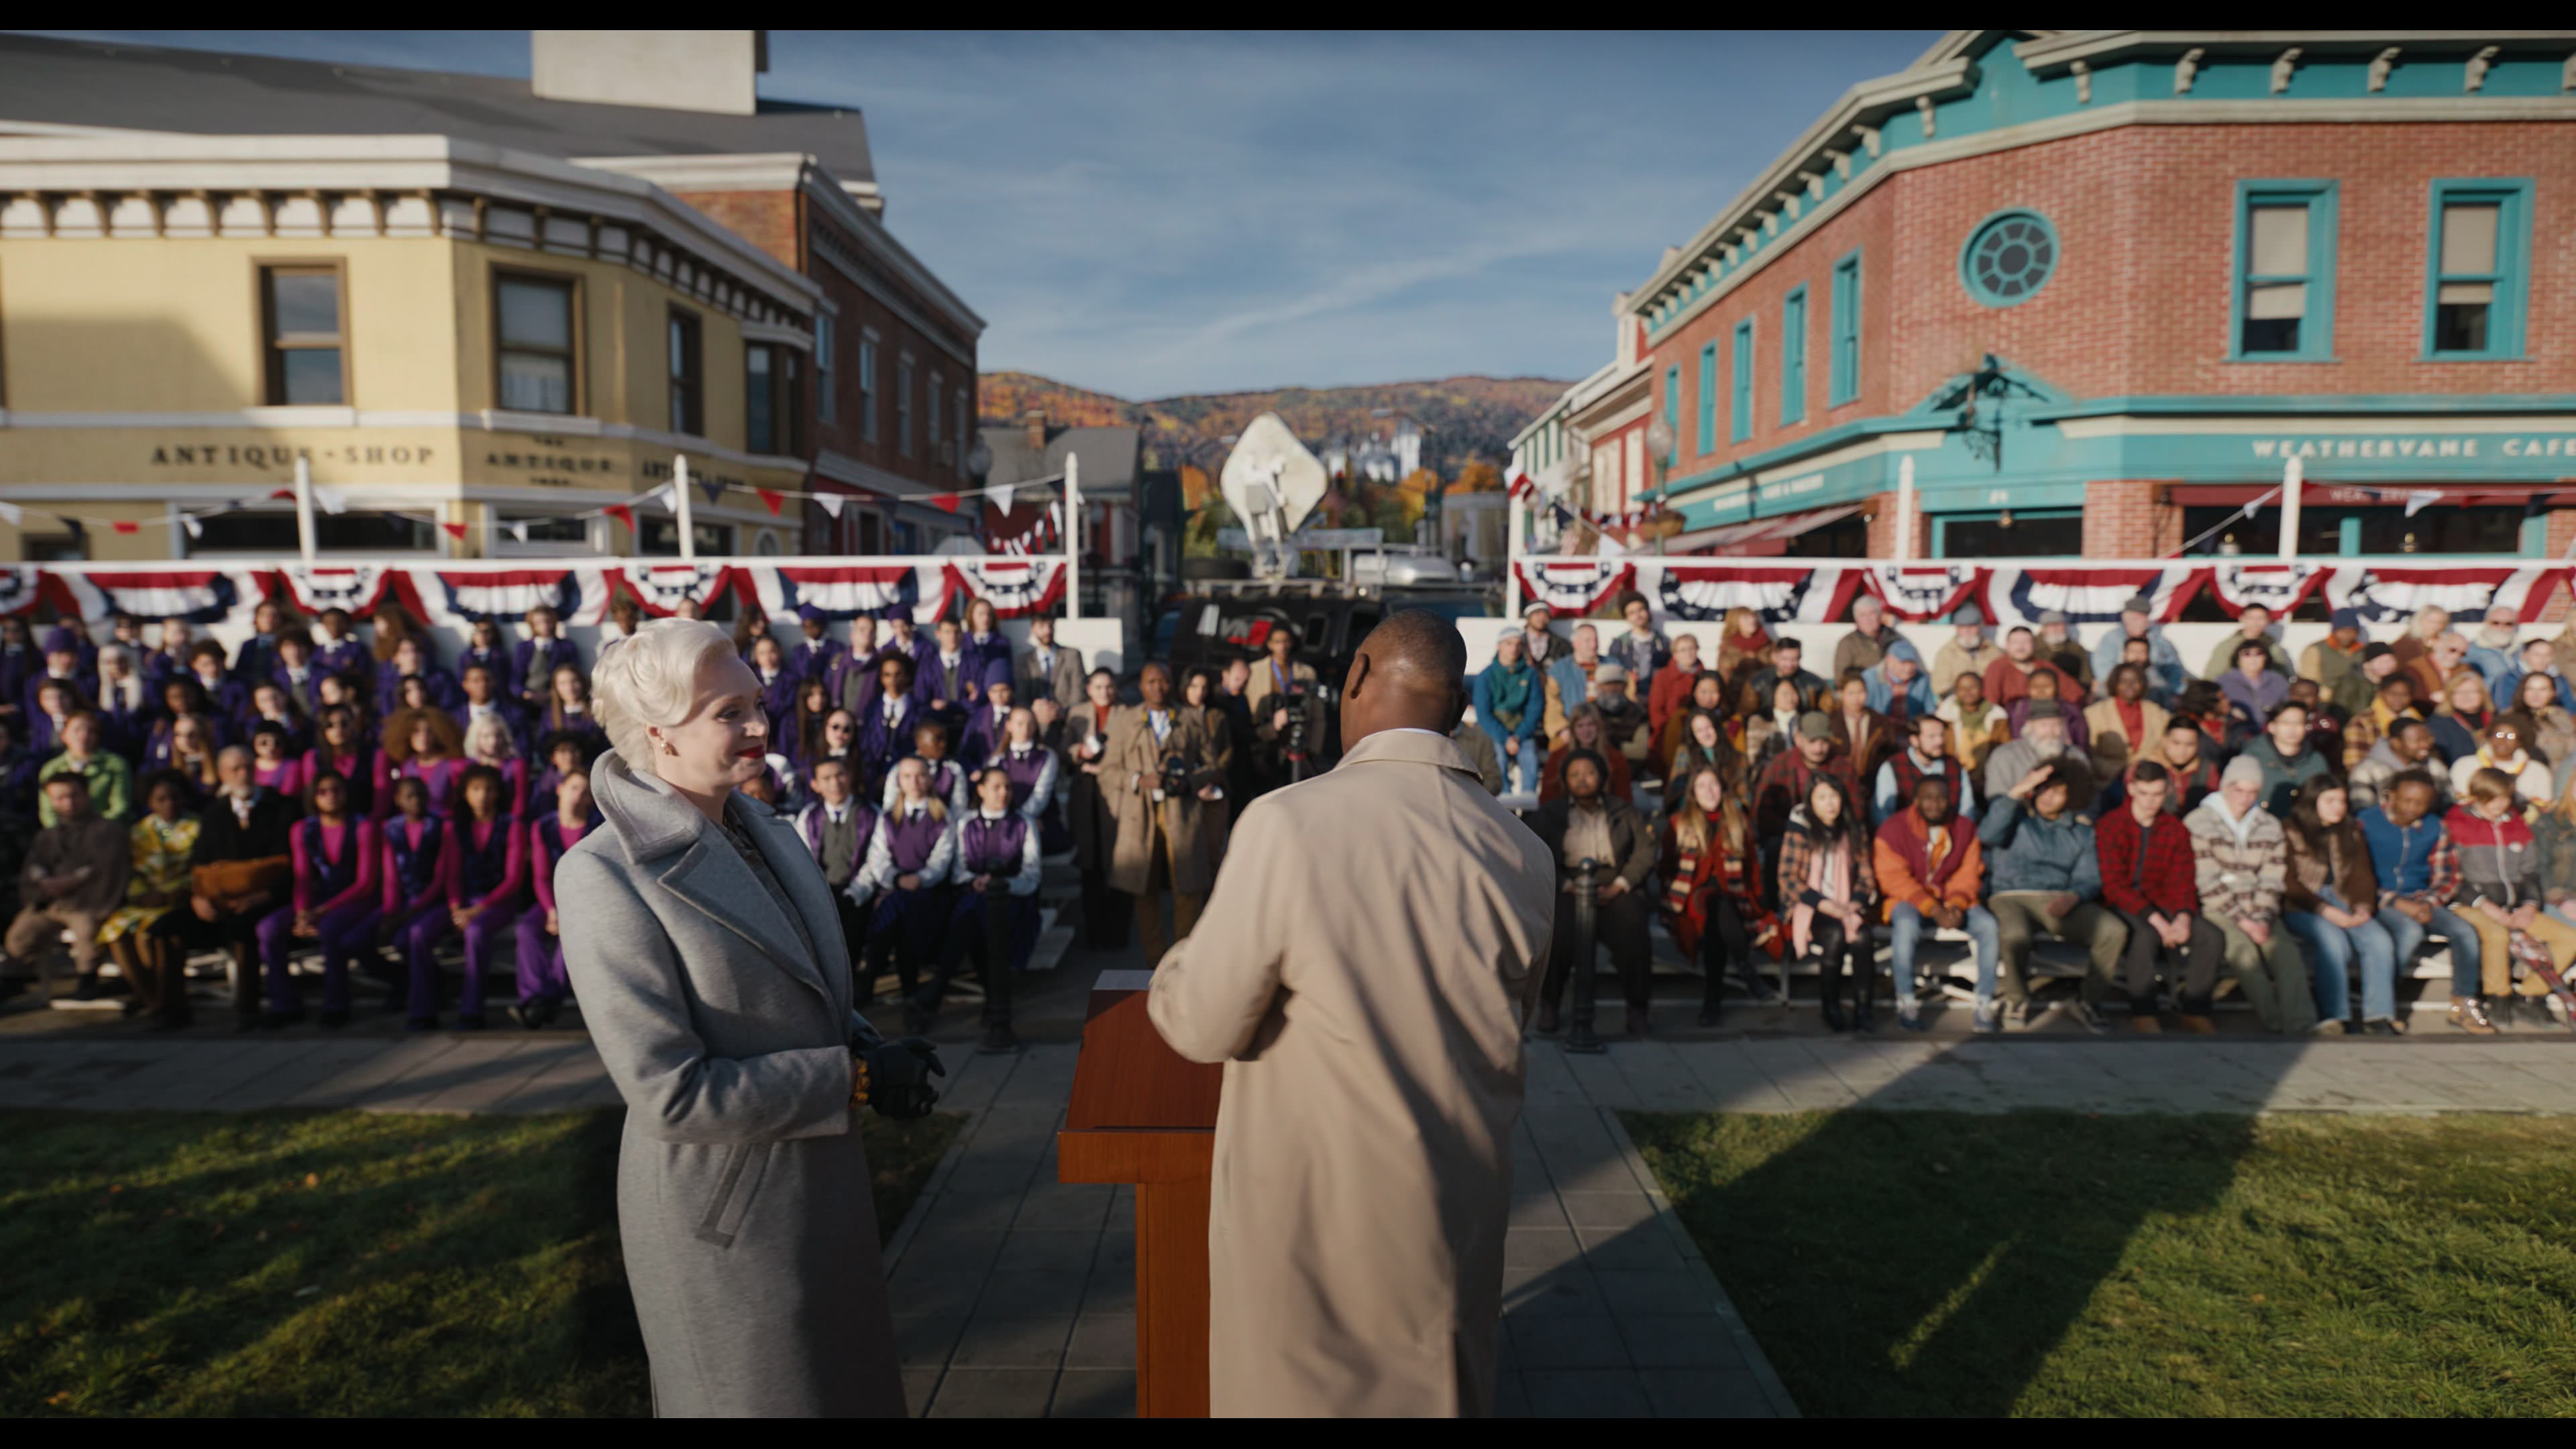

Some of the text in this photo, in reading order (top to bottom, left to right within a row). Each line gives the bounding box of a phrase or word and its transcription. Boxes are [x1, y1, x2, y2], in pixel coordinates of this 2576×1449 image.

[345, 445, 435, 464] SHOP
[2252, 438, 2576, 458] WEATHERVANE CAFE
